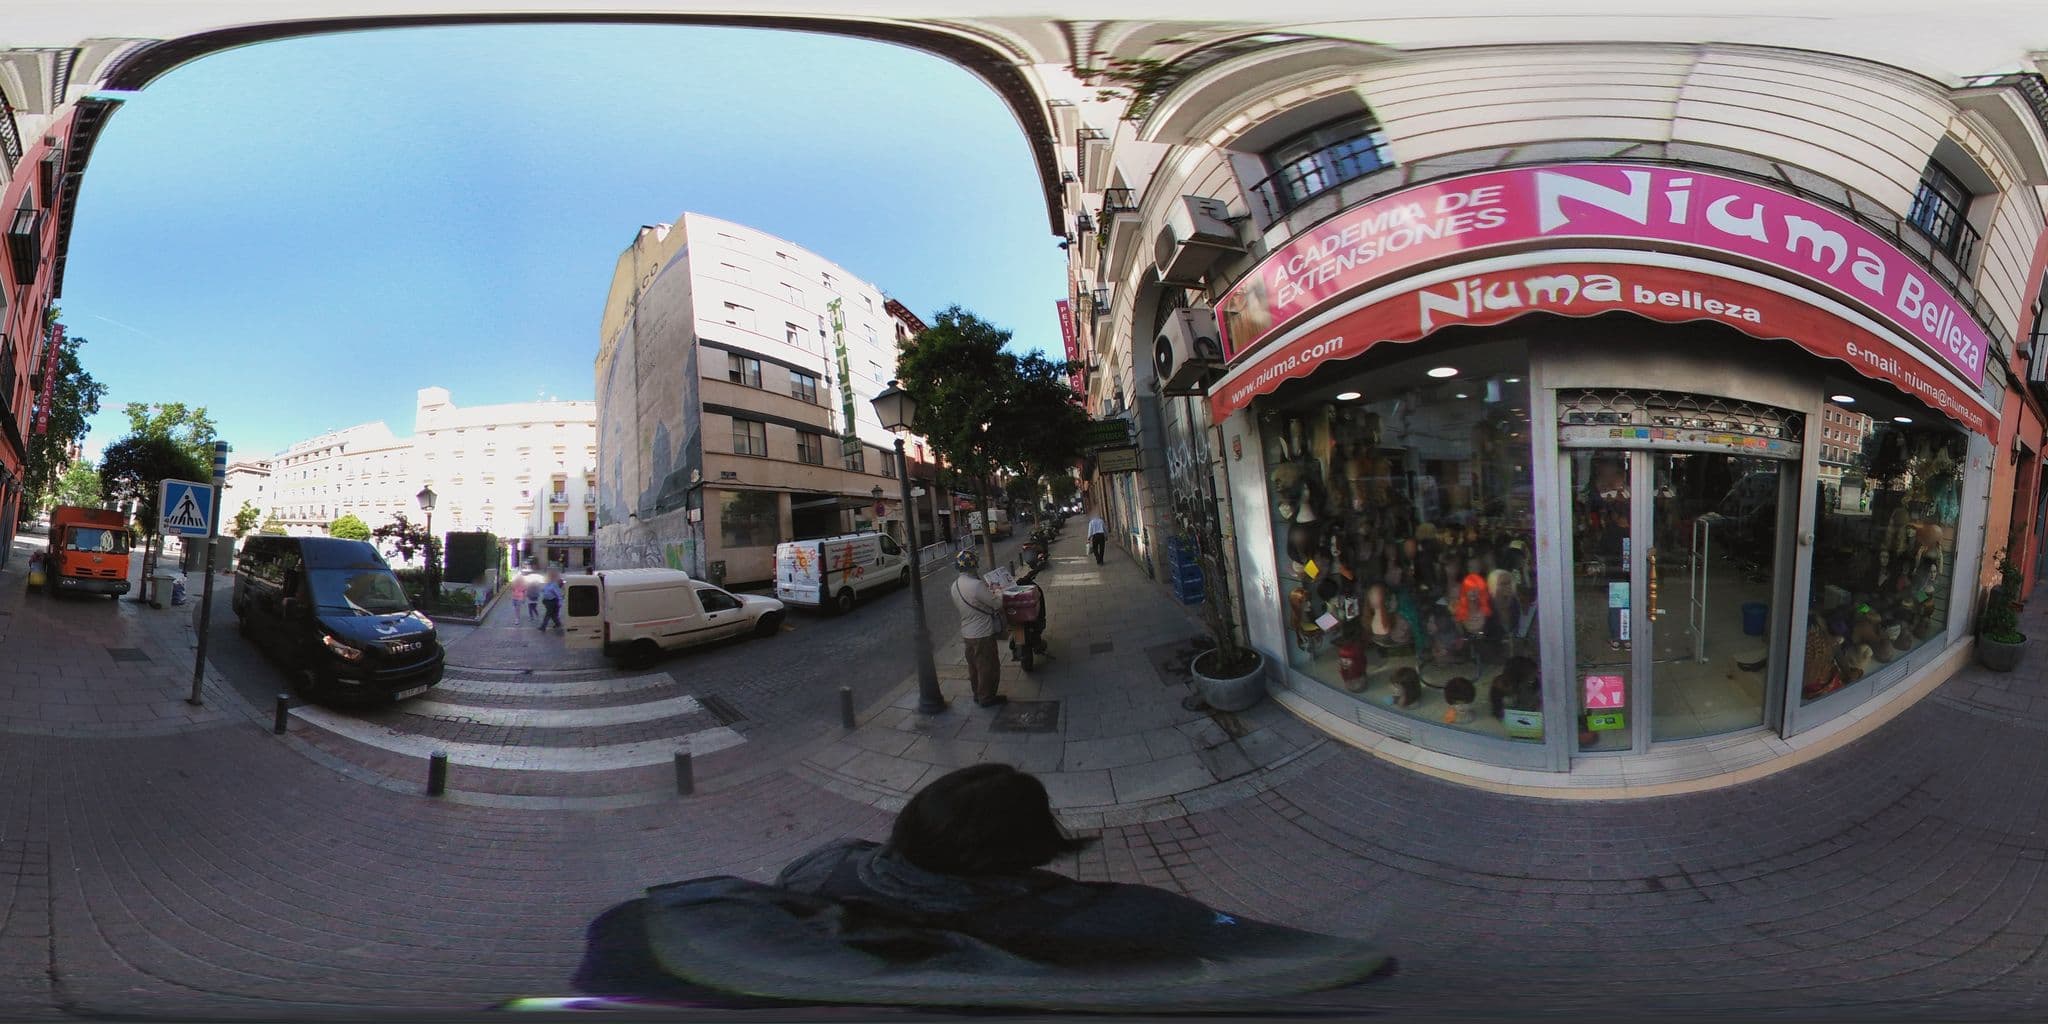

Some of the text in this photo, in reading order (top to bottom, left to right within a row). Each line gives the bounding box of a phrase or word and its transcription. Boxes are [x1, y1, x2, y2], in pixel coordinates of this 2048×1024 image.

[1275, 185, 1504, 287] ACADEMIA DE
[1277, 207, 1508, 309] EXTENSIONES
[1534, 170, 1979, 373] Niuma Belleza
[1060, 306, 1072, 343] PETIT
[1420, 274, 1761, 336] Niuma belleza
[41, 329, 61, 412] PETIT PALACE
[829, 309, 857, 438] HOTEL
[1231, 336, 1344, 404] www.niuma.com
[1846, 341, 1984, 427] e-mail: niuma@niuma.com
[391, 641, 422, 655] IVECO
